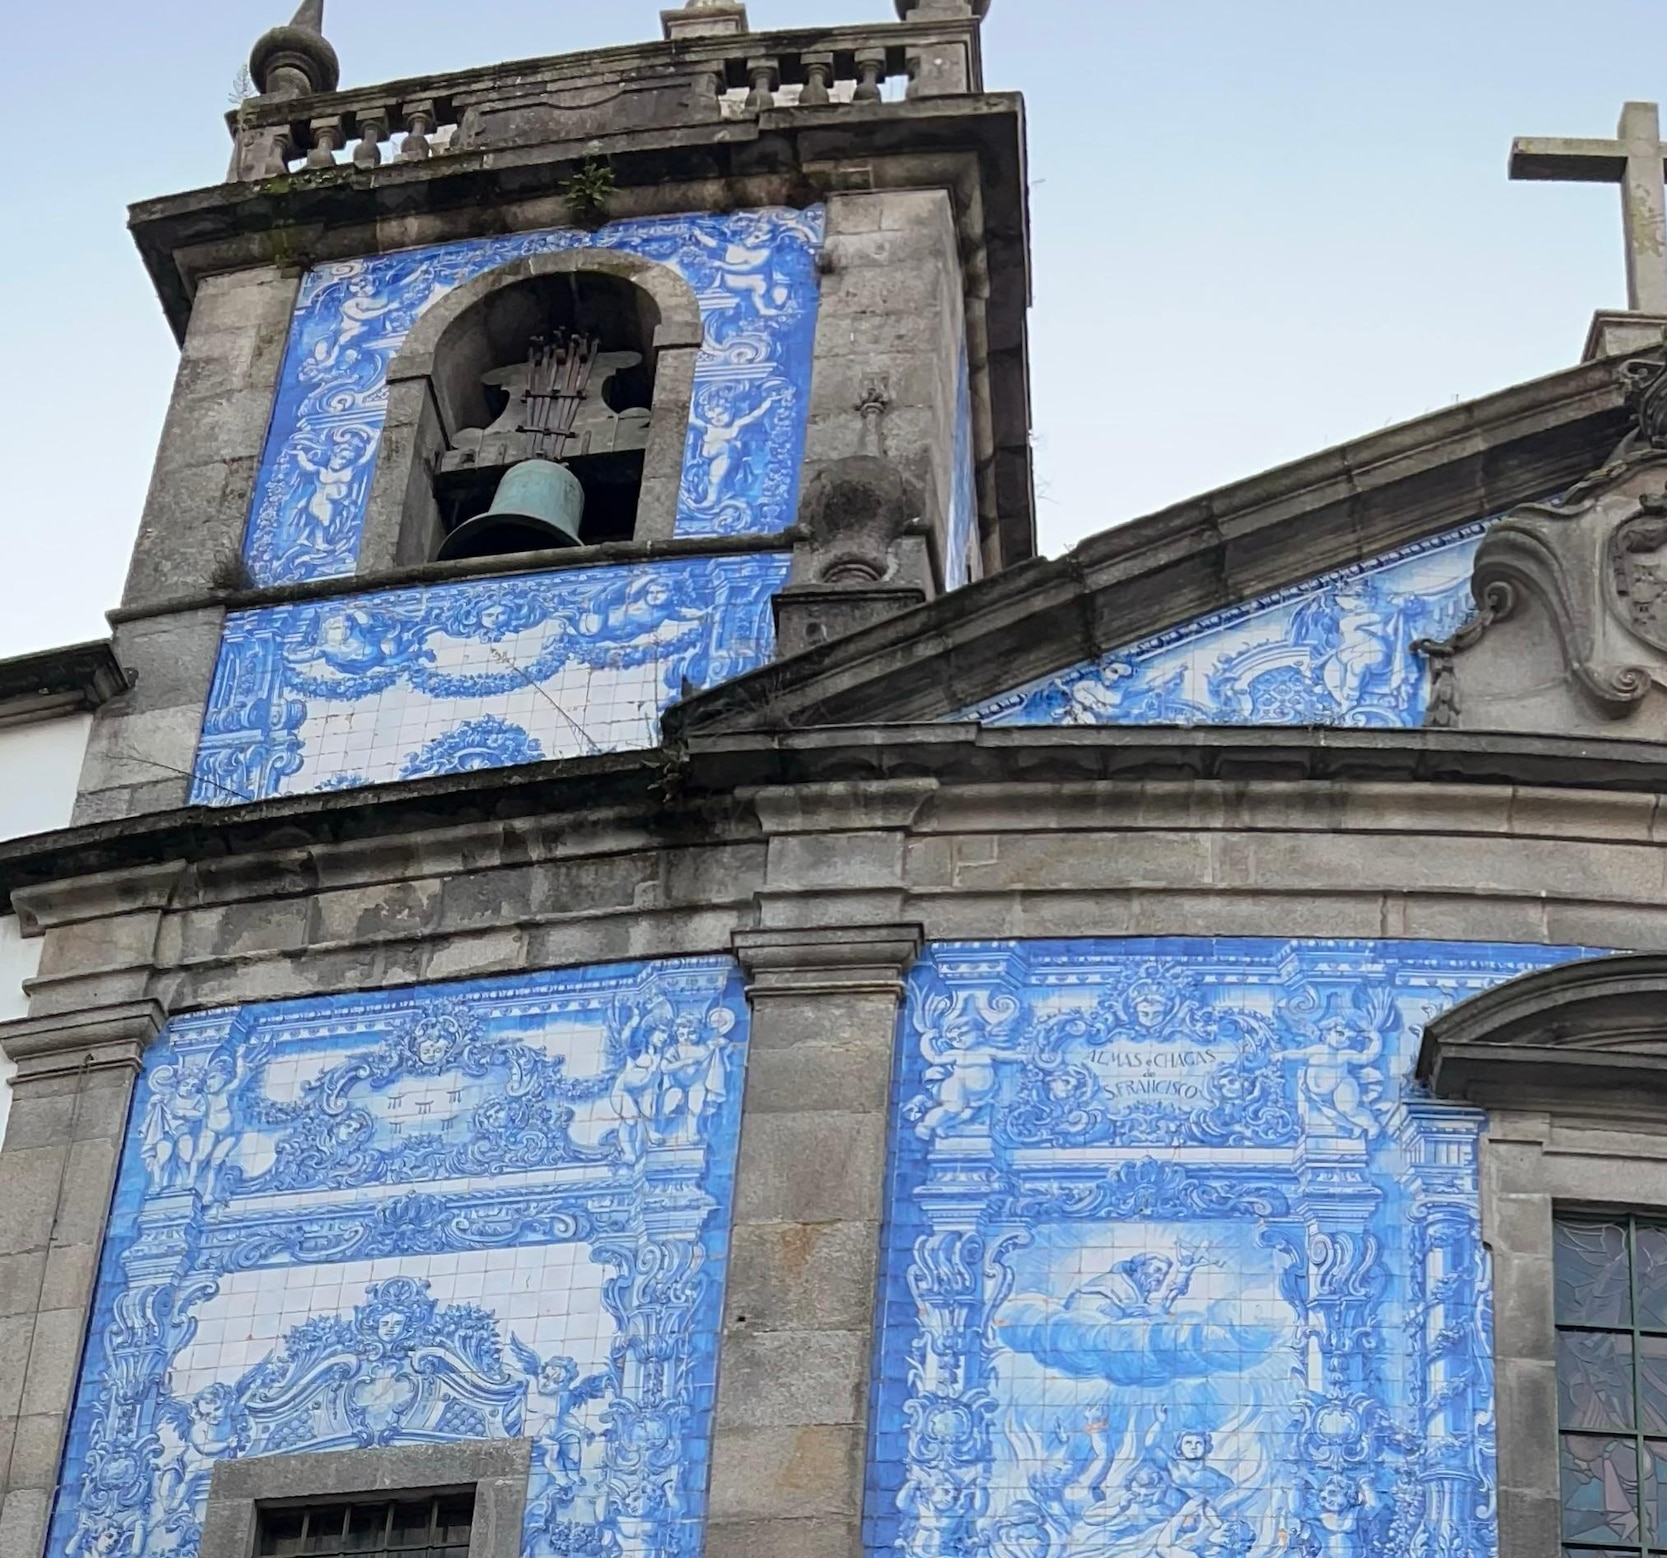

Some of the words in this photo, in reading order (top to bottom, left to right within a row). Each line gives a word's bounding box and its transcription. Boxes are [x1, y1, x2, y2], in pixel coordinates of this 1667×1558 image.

[1087, 1049, 1142, 1068] ALMAS
[1153, 1049, 1216, 1068] CHAGAS
[1142, 1068, 1156, 1078] de
